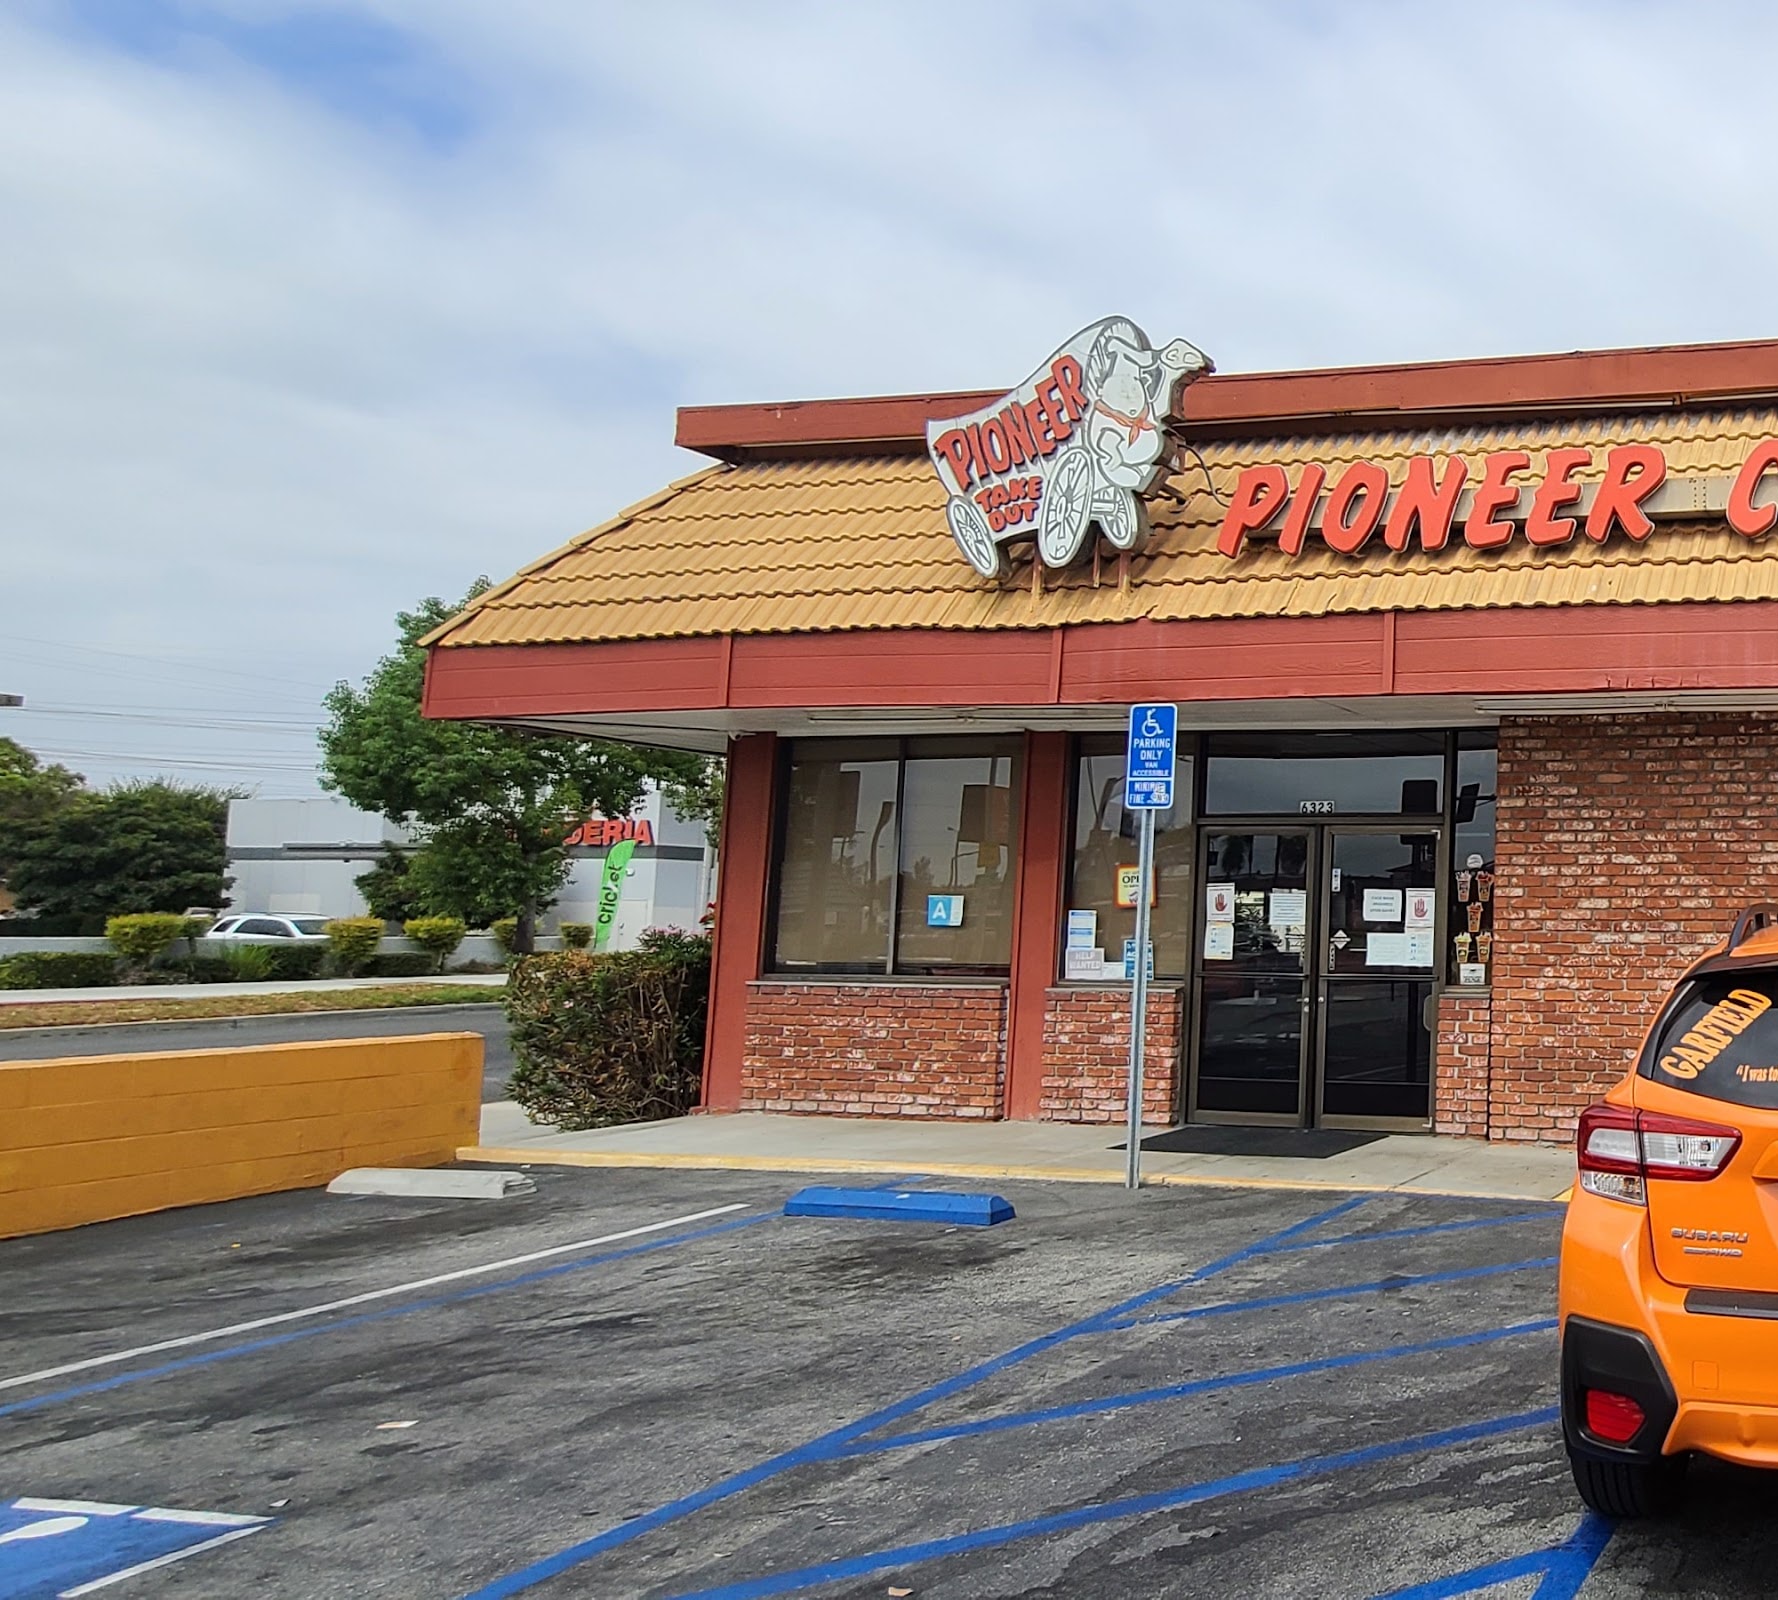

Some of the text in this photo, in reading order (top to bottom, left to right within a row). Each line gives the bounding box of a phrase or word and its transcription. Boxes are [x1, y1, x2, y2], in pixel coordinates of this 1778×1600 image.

[933, 354, 1088, 492] PIONEER
[974, 476, 1042, 514] TAKE
[1216, 443, 1668, 560] PIONEER
[988, 502, 1040, 532] OUT
[1133, 738, 1171, 748] PARKING
[1140, 750, 1163, 760] ONLY
[1132, 769, 1169, 777] ACCESSIBLE
[1129, 794, 1145, 804] FINE
[1301, 801, 1333, 814] 6323
[932, 901, 947, 919] A
[1069, 961, 1101, 969] WANTED
[1660, 989, 1773, 1080] GARFIELD
[1749, 1067, 1768, 1082] was
[1671, 1227, 1748, 1244] SUBARU
